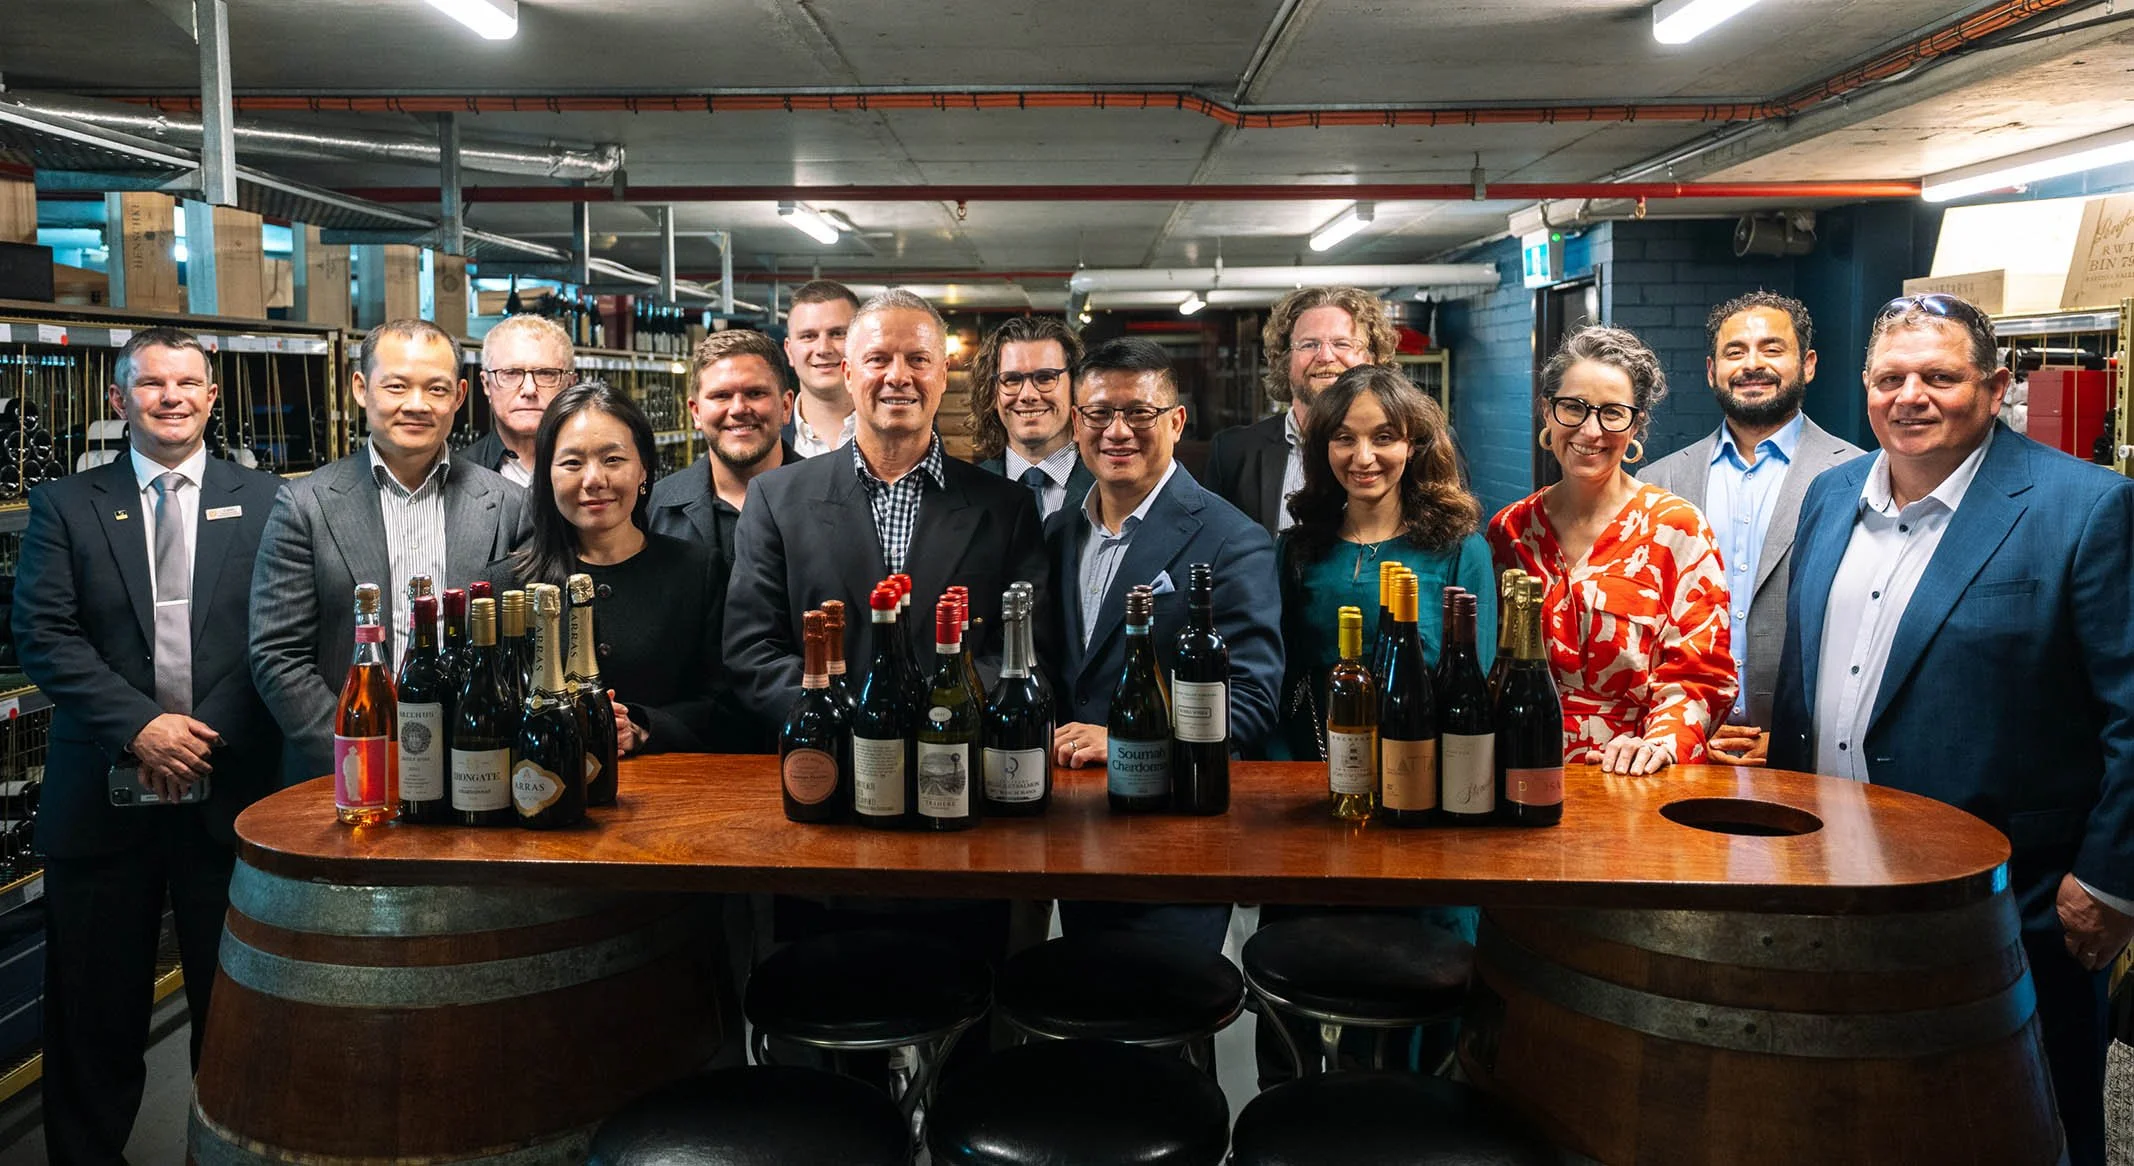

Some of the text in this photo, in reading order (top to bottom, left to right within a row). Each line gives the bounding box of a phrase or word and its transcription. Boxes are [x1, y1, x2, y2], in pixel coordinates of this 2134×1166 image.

[535, 623, 545, 672] ARRAS
[569, 613, 580, 658] ARRAS
[1117, 746, 1166, 760] Soumah
